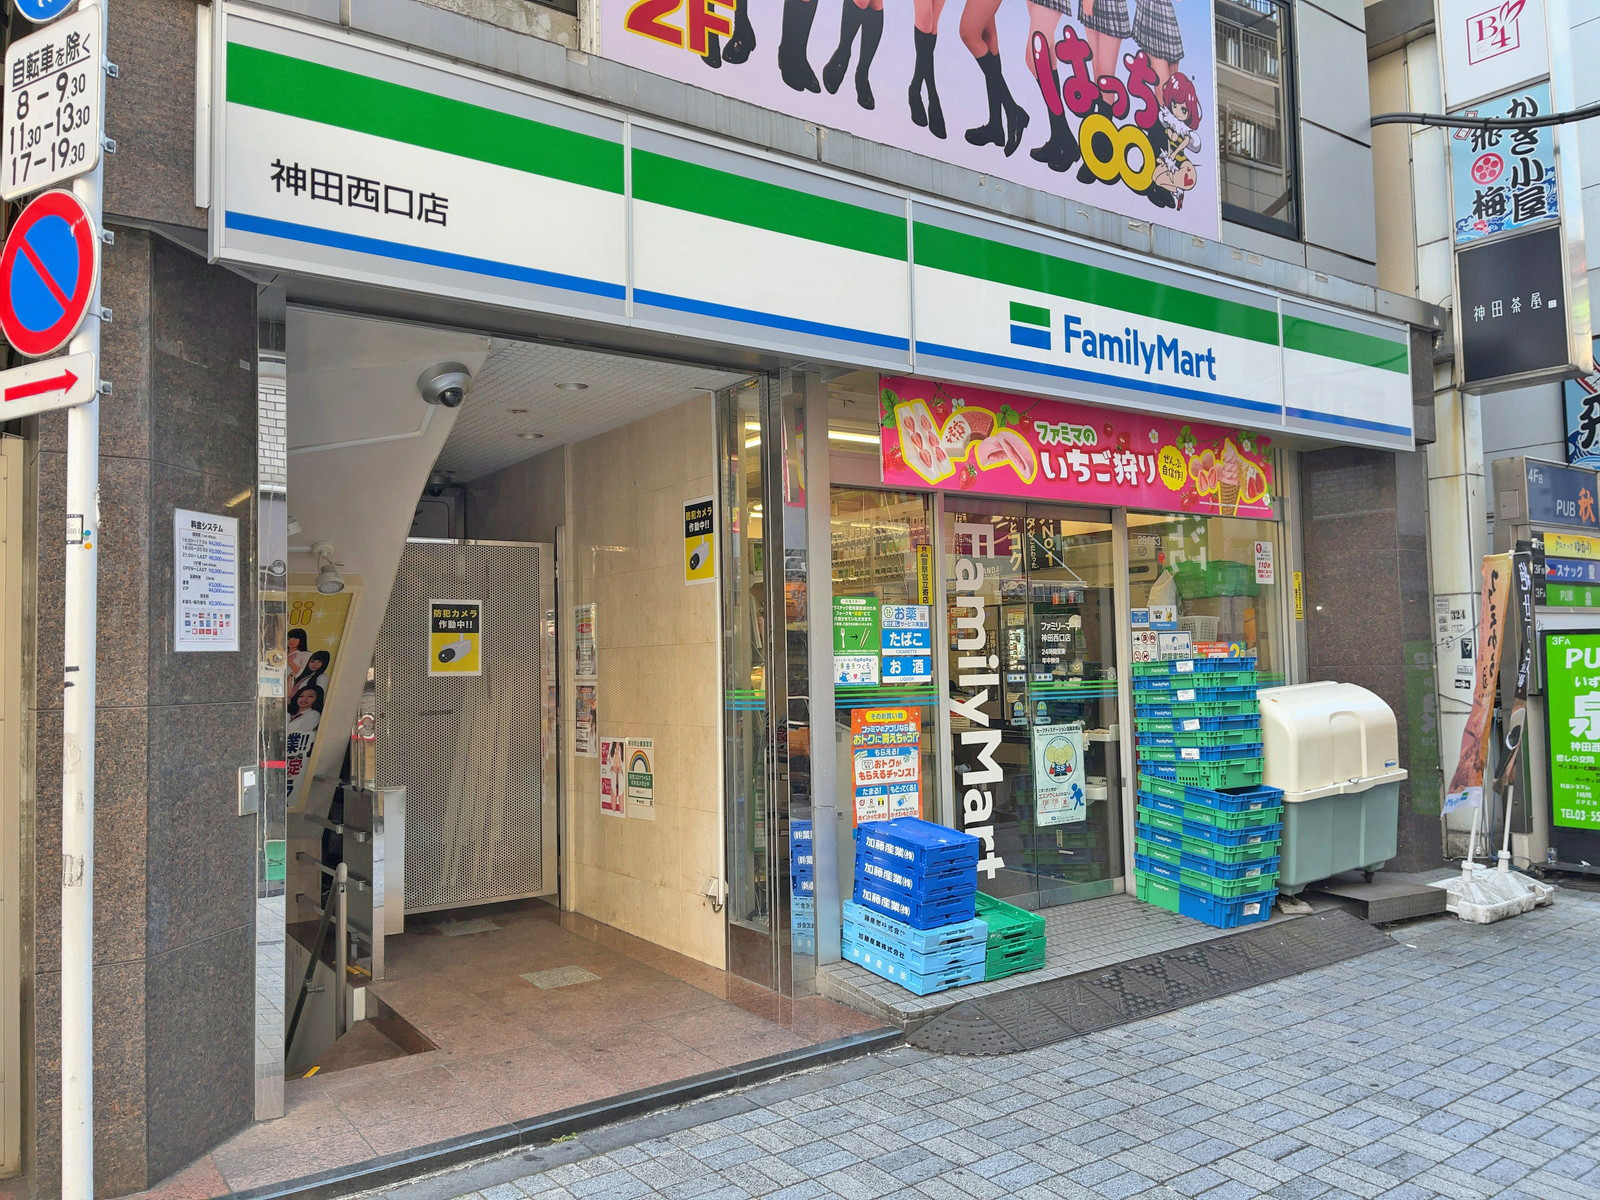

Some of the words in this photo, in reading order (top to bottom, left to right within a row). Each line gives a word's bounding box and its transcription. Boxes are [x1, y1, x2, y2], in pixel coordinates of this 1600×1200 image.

[12, 31, 91, 88] 自転車を除く
[270, 158, 449, 227] 神田西口店
[1473, 292, 1542, 322] 神田茶屋
[1064, 314, 1217, 381] FamilyMart
[1035, 422, 1097, 445] ファミマの
[1040, 448, 1156, 486] いちご狩り
[1163, 454, 1182, 468] ぜんぶ
[1162, 465, 1184, 482] 自信作!
[1556, 499, 1576, 517] PUB
[1578, 487, 1597, 523] 秋
[686, 507, 713, 520] 防犯カメラ
[191, 520, 224, 532] 料金システム
[689, 520, 710, 532] 作動中!!
[1557, 565, 1583, 578] スナック
[1560, 590, 1573, 602] PUB
[433, 609, 478, 618] 防犯カメラ
[894, 606, 917, 620] お薬
[438, 620, 473, 629] 作動中!!
[890, 632, 923, 646] たばこ
[1041, 634, 1071, 642] 神田西口店
[1552, 636, 1571, 646] 3FA
[890, 659, 924, 674] お酒
[950, 522, 1005, 879] FamilyMart
[874, 748, 899, 756] もらえる!
[874, 759, 902, 769] おトクが
[859, 768, 915, 781] もらえるチャンス!
[865, 836, 915, 862] 加藤産業(株)
[864, 862, 913, 890] 加藤産業(株)
[862, 889, 911, 917] 加藤産業(株)
[858, 932, 905, 959] 加藤産業株式会社
